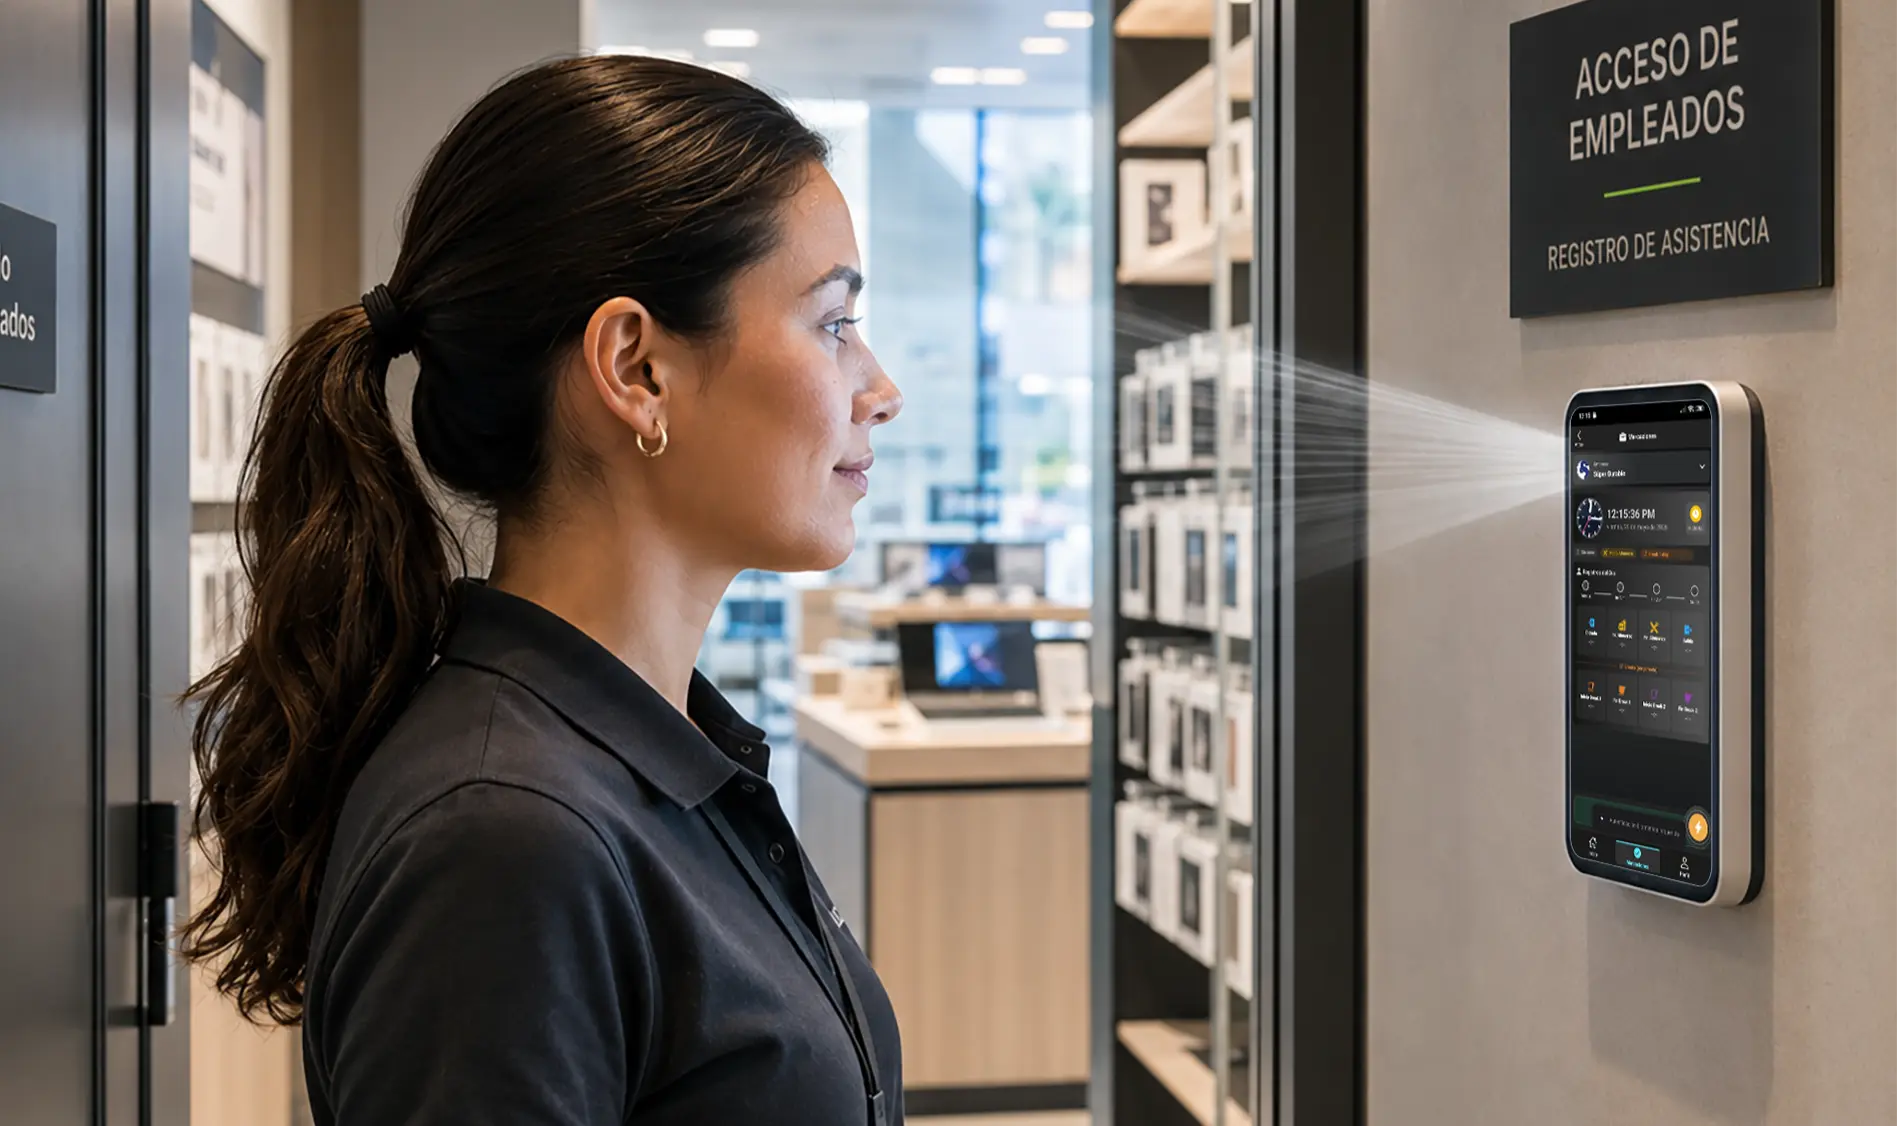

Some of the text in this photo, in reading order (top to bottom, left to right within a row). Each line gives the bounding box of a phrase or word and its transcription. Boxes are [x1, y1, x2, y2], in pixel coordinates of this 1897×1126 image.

[1575, 18, 1740, 100] ACCESO DE
[1569, 85, 1745, 162] EMPLEADOS
[1548, 215, 1770, 271] REGISTRO DE ASISTENCIA
[1607, 508, 1656, 519] 12:15:36 PM
